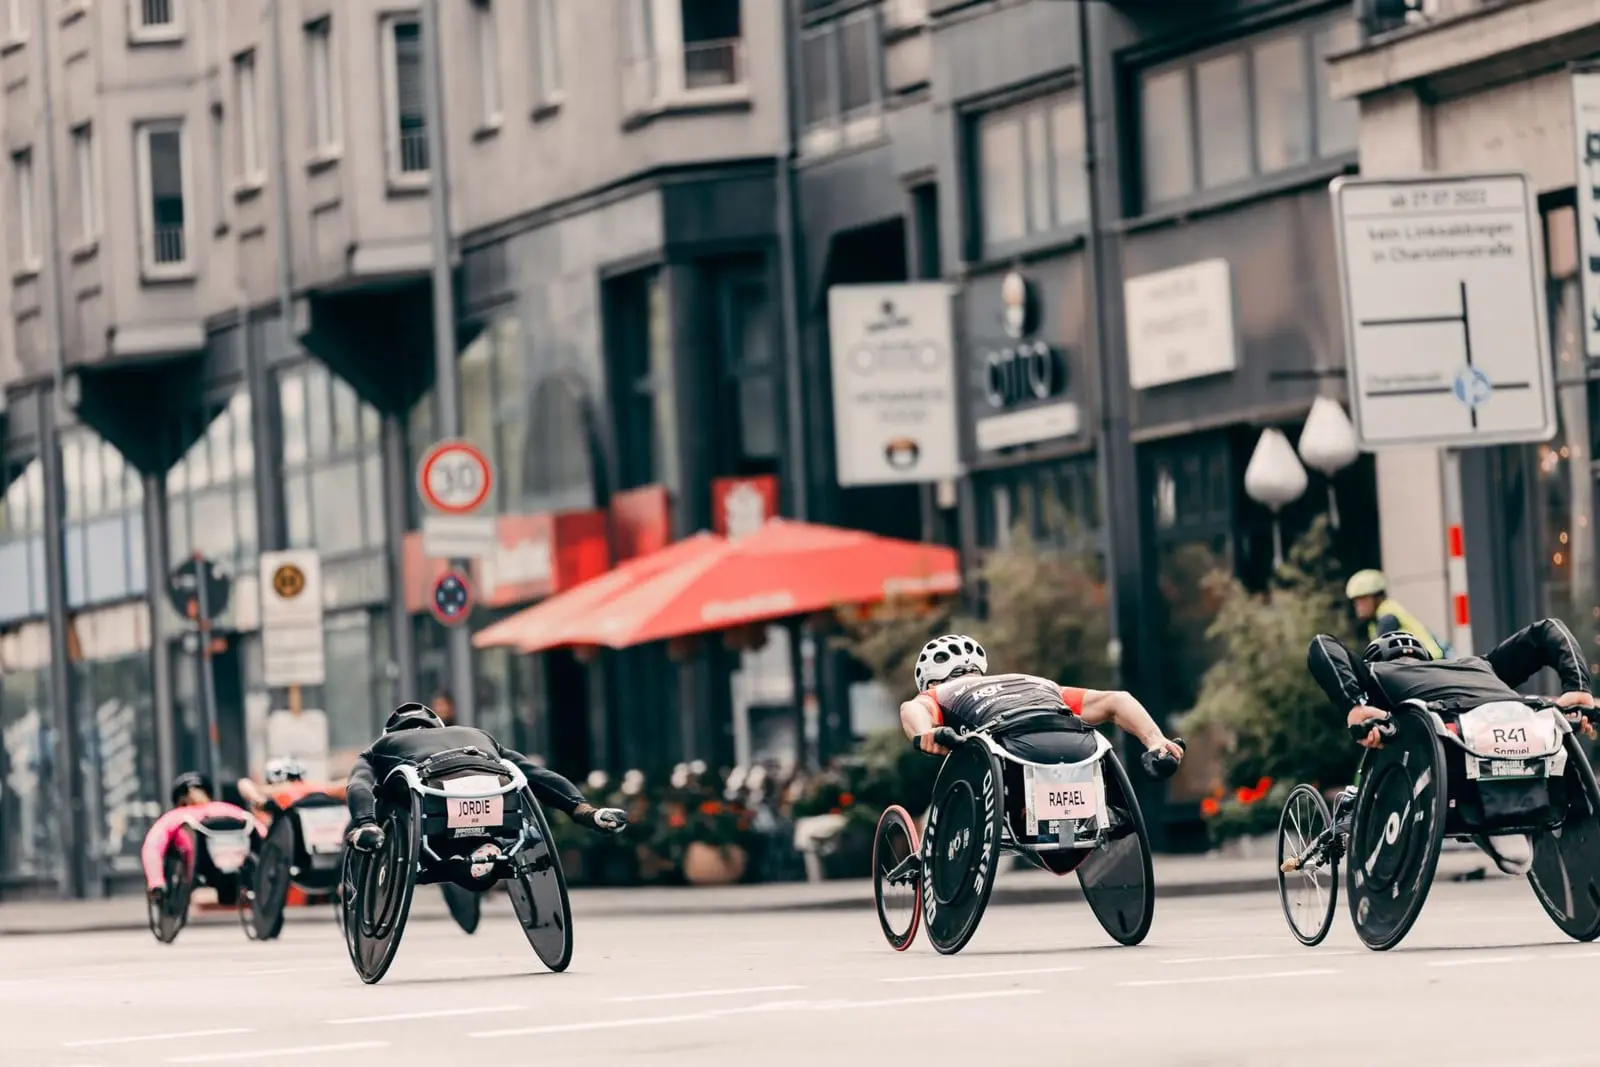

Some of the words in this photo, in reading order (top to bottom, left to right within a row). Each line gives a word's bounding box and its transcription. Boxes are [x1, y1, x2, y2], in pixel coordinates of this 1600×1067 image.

[436, 462, 477, 495] 30
[1492, 727, 1527, 743] R41
[1049, 790, 1085, 807] RAFAEL
[458, 799, 490, 817] JORDIE
[973, 769, 994, 896] QUICKIE
